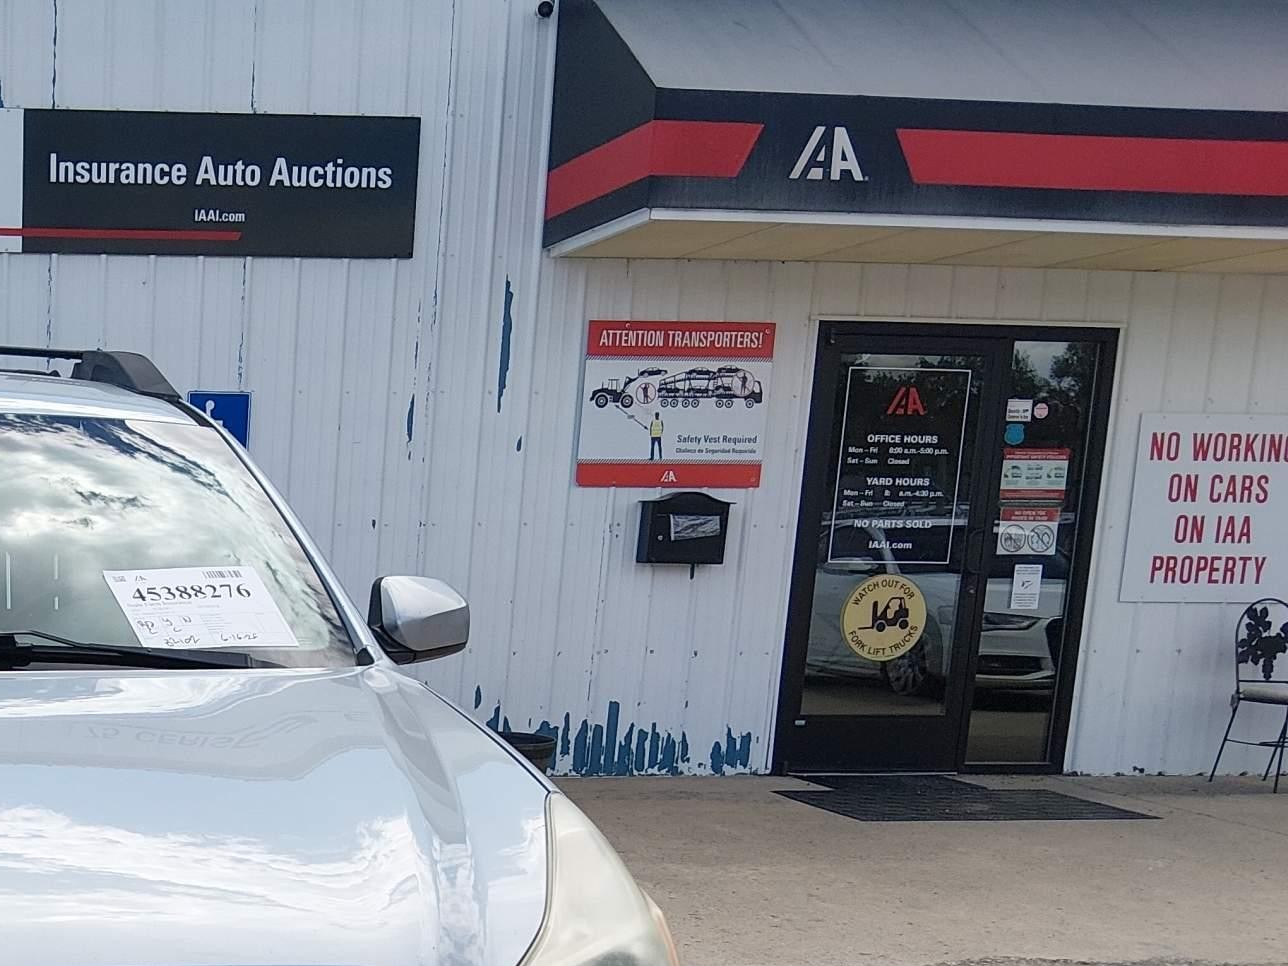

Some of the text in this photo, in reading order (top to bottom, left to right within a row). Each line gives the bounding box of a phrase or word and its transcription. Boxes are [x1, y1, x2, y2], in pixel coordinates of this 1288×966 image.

[49, 153, 393, 189] Insurance Auto Auctions
[194, 209, 246, 223] IAAI.com
[599, 330, 763, 348] ATTENTION TRANSPORTERS!
[676, 434, 758, 446] Safety Vest Required
[867, 434, 938, 444] OFFICE HOURS
[1150, 432, 1288, 463] NO WORKIN
[866, 477, 930, 486] YARD HOURS
[1168, 474, 1270, 503] ON CARS
[853, 519, 932, 529] NO PARTS SOLD
[1174, 515, 1251, 544] ON IAA
[868, 540, 912, 549] IAAI.com
[1149, 555, 1267, 584] PROPERTY
[132, 583, 251, 602] 45388276
[852, 579, 915, 606] WATCH OUT FOR
[848, 625, 919, 656] FORK LIFT TRUCKS
